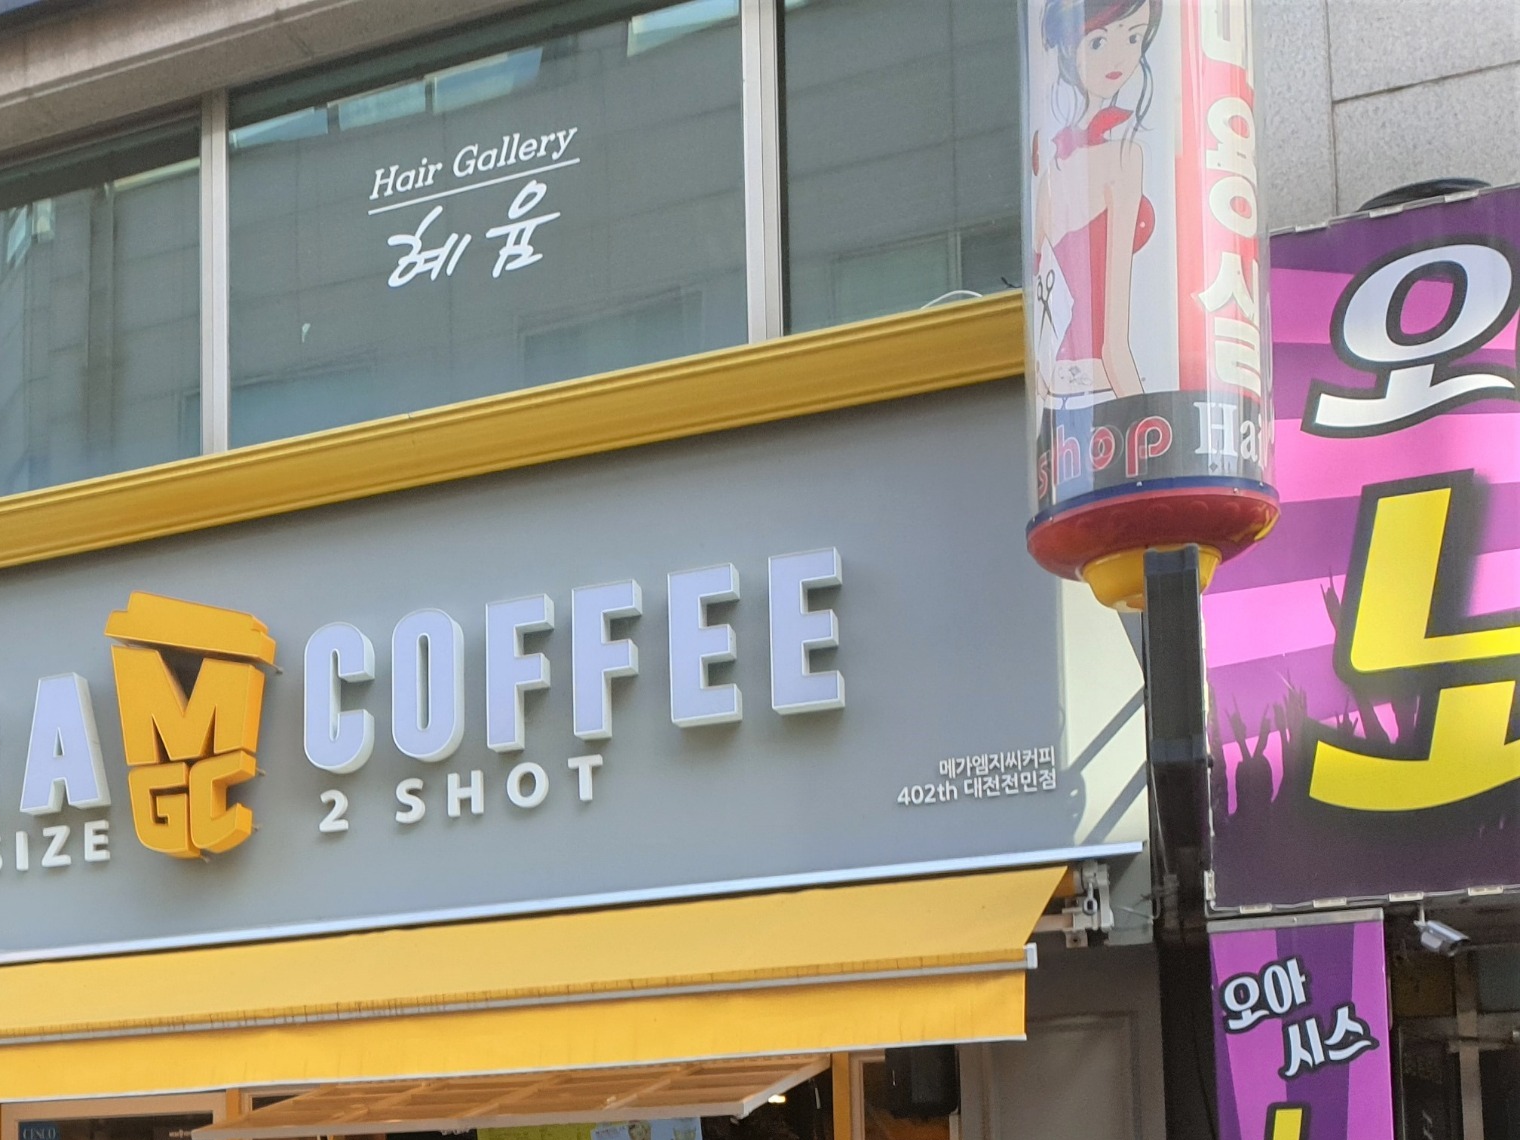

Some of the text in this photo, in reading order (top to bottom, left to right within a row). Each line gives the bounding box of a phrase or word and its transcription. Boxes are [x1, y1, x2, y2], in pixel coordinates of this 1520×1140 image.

[369, 127, 578, 200] Hair Gallery
[304, 546, 846, 775] COFFEE
[319, 789, 349, 833] 2
[395, 754, 603, 825] SHOT
[897, 768, 1057, 806] 402th 대전전민점
[939, 745, 1055, 778] 메가엠지씨커피
[1224, 957, 1307, 1031] 오아
[1285, 1005, 1375, 1077] 시스
